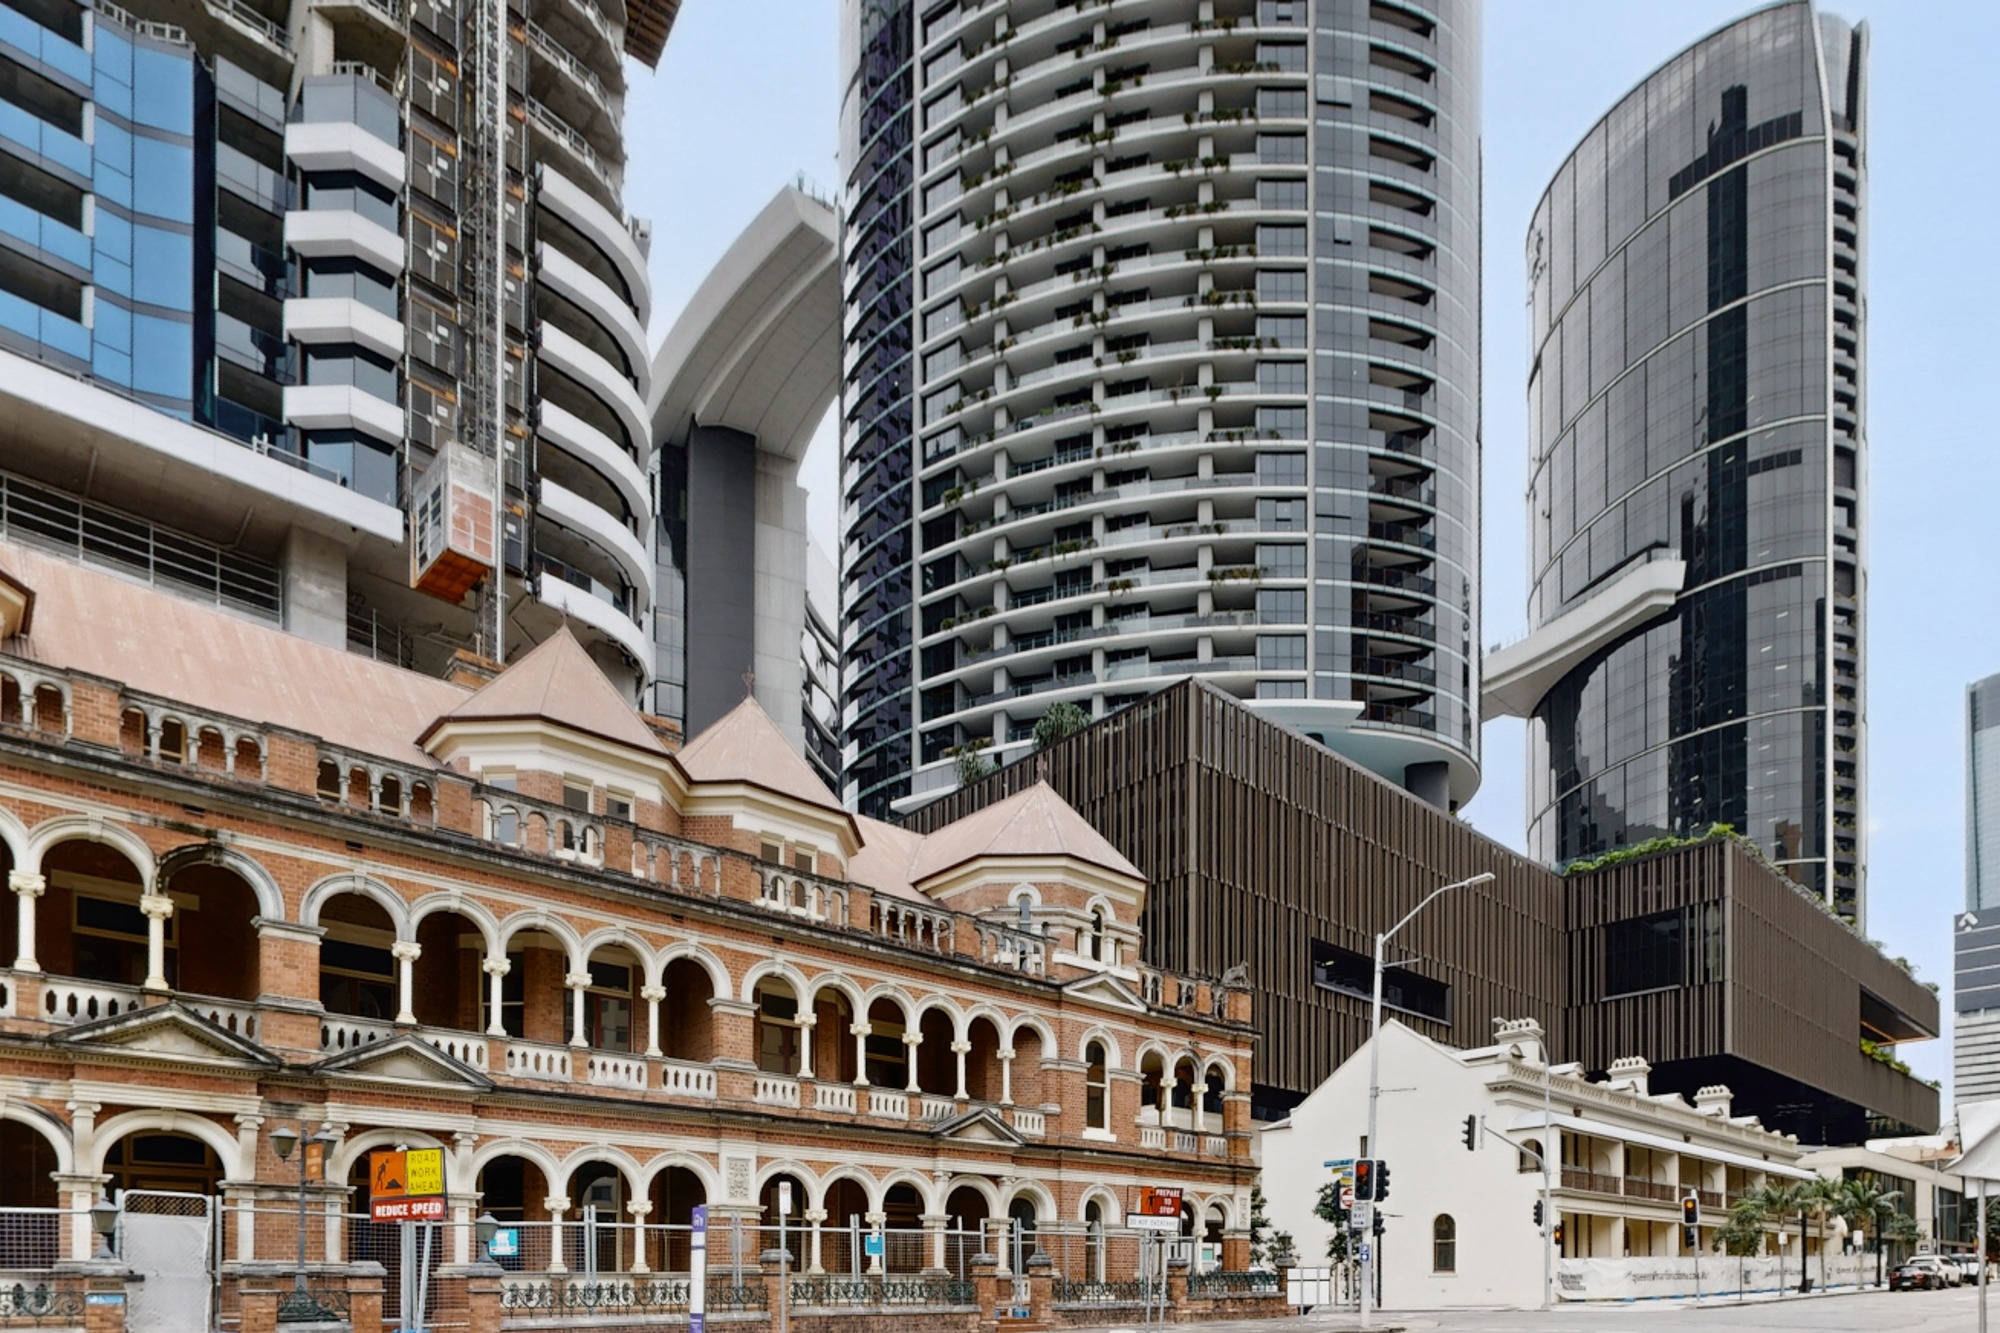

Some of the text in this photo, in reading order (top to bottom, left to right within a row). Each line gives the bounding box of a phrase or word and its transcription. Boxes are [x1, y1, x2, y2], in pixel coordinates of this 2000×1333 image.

[411, 1152, 436, 1164] ROAD
[411, 1167, 438, 1178] WORK
[410, 1180, 441, 1192] AHEAD
[1155, 1188, 1180, 1197] PREPARE
[1163, 1197, 1172, 1205] TO
[375, 1202, 441, 1217] REDUCE SPEED
[1159, 1206, 1175, 1214] STOP
